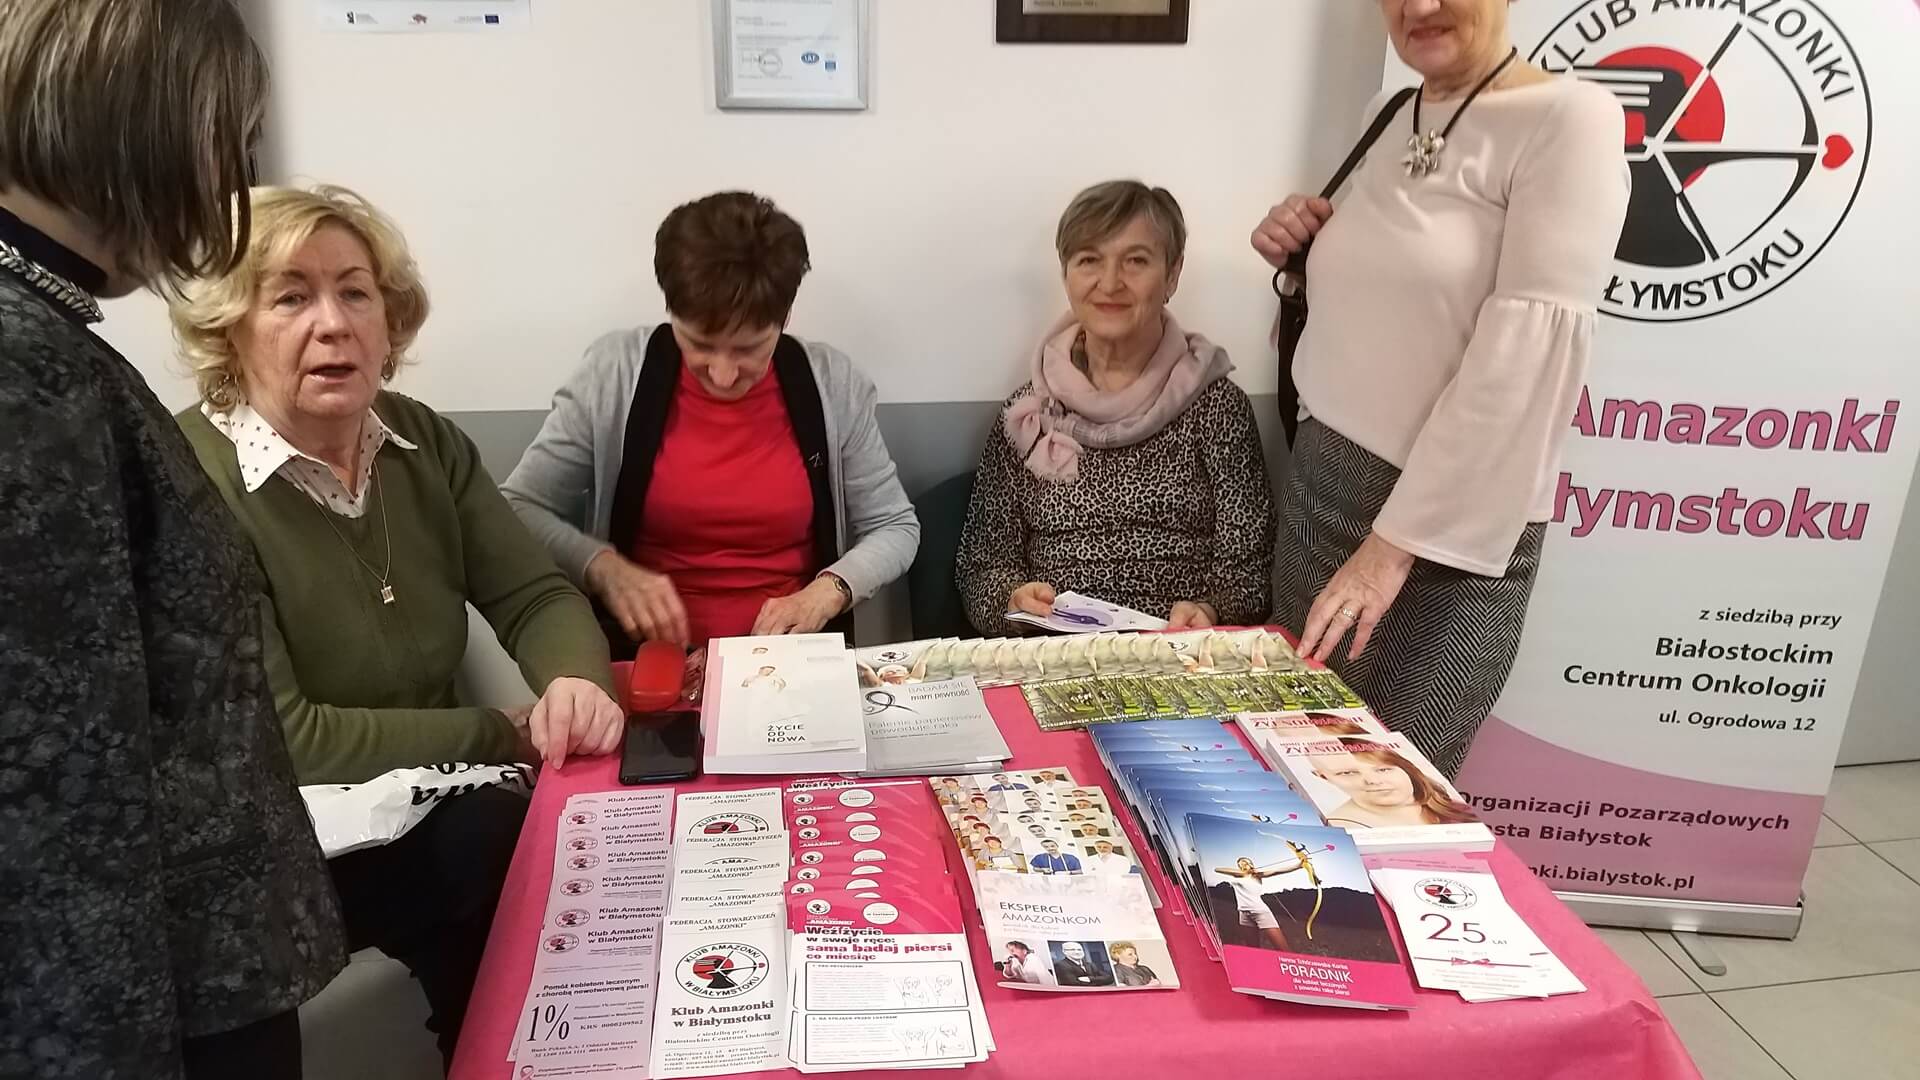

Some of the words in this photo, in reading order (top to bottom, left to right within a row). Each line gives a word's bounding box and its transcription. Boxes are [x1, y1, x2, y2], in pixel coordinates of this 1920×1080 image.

[1570, 384, 1901, 454] Amazonki
[1699, 608, 1711, 621] z
[1715, 607, 1793, 627] siedzibą
[1799, 613, 1843, 631] przy
[1655, 636, 1834, 666] Białostockim
[1563, 664, 1683, 692] Centrum
[1691, 672, 1828, 703] Onkologii
[1658, 710, 1681, 724] ul.
[1687, 711, 1787, 731] Ogrodowa
[1792, 716, 1816, 732] 12
[767, 735, 806, 743] NOWA
[1598, 803, 1790, 833] Pozarządowych
[1539, 824, 1653, 849] Białystok
[620, 905, 664, 913] Amazonki
[999, 901, 1064, 914] EKSPERCI
[669, 918, 713, 926] FEDERACJA
[1001, 912, 1102, 925] AMAZONKOM
[1419, 913, 1487, 944] 25
[609, 926, 655, 936] Amazonki
[821, 936, 861, 944] swoje
[684, 948, 709, 964] KLUB
[711, 944, 761, 959] AMAZONKI
[806, 944, 848, 953] sama
[852, 943, 899, 954] badaj
[904, 942, 953, 954] piersi
[825, 953, 877, 961] miesiąc
[1280, 963, 1354, 983] PORADNIK
[692, 976, 761, 997] BIAŁYMSTOKU
[671, 1005, 704, 1016] Klub
[707, 999, 775, 1014] Amazonki
[526, 1003, 570, 1042] 1%
[673, 1020, 684, 1028] w
[688, 1012, 772, 1028] Białymstoku
